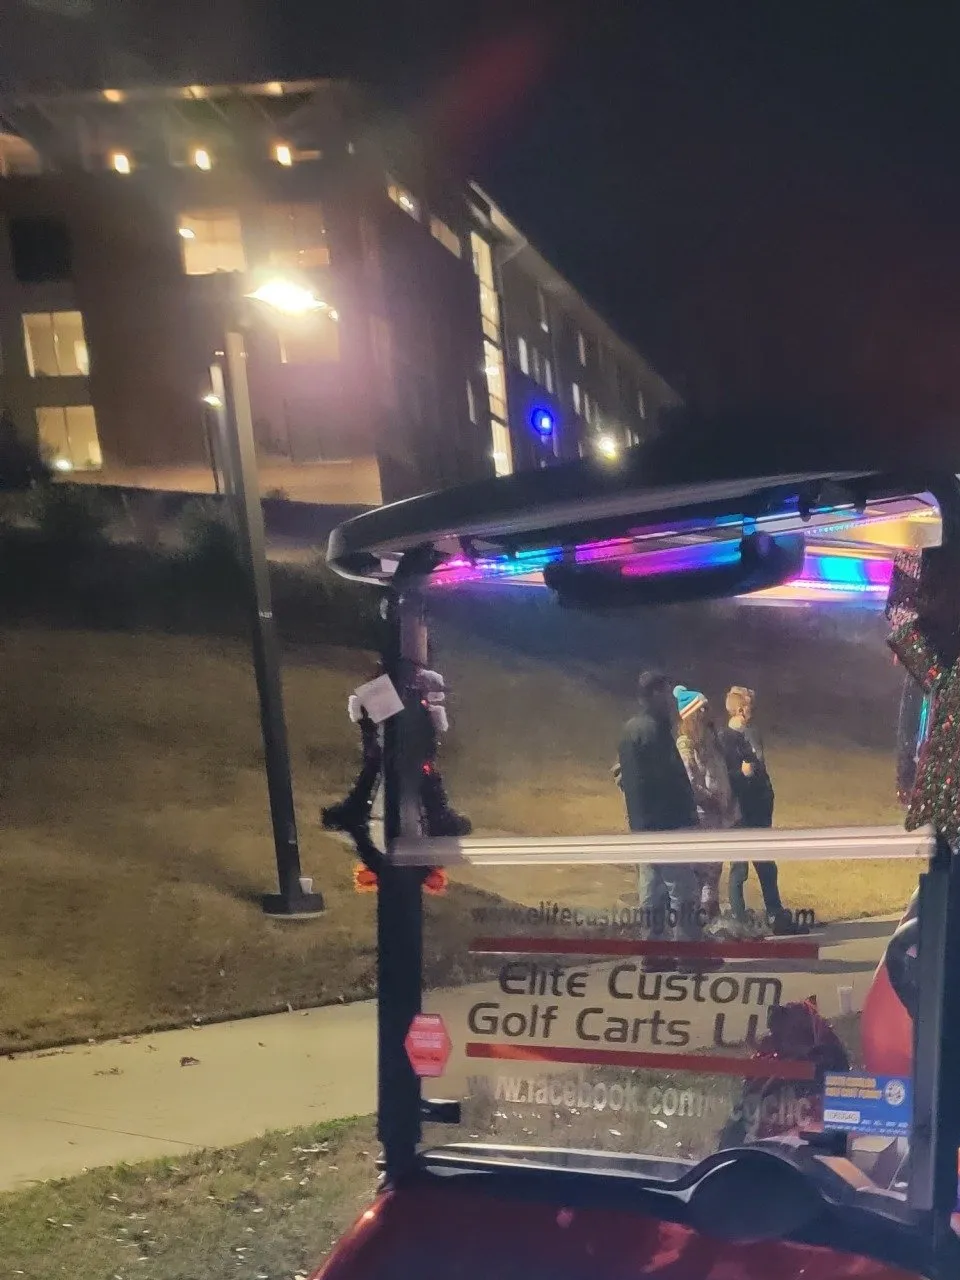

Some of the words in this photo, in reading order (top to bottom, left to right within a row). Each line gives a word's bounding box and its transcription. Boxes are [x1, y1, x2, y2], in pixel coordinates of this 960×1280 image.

[501, 961, 589, 998] Elite
[608, 964, 782, 1006] Custom
[468, 1002, 559, 1038] Golf
[576, 1007, 691, 1047] Carts
